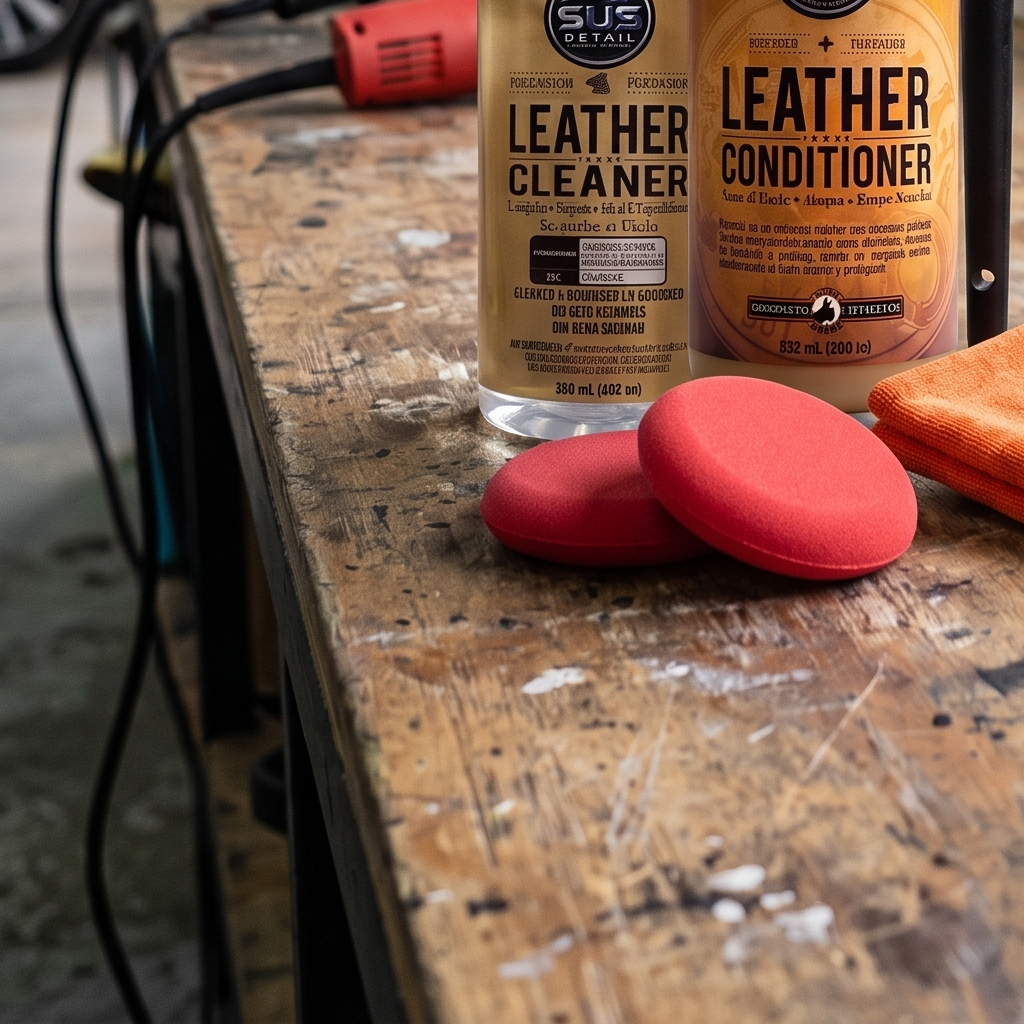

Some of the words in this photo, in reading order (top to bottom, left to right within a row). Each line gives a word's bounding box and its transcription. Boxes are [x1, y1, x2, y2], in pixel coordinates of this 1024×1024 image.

[557, 5, 643, 31] SUS
[565, 33, 635, 42] DETAIL
[722, 66, 930, 132] LEATHER
[509, 104, 689, 154] LEATHER
[721, 142, 932, 188] CONDITIONER
[509, 164, 688, 197] CLEANER
[804, 341, 823, 355] mL
[825, 341, 851, 356] (200
[555, 381, 575, 395] 380
[578, 383, 594, 396] mL
[597, 382, 622, 398] (402
